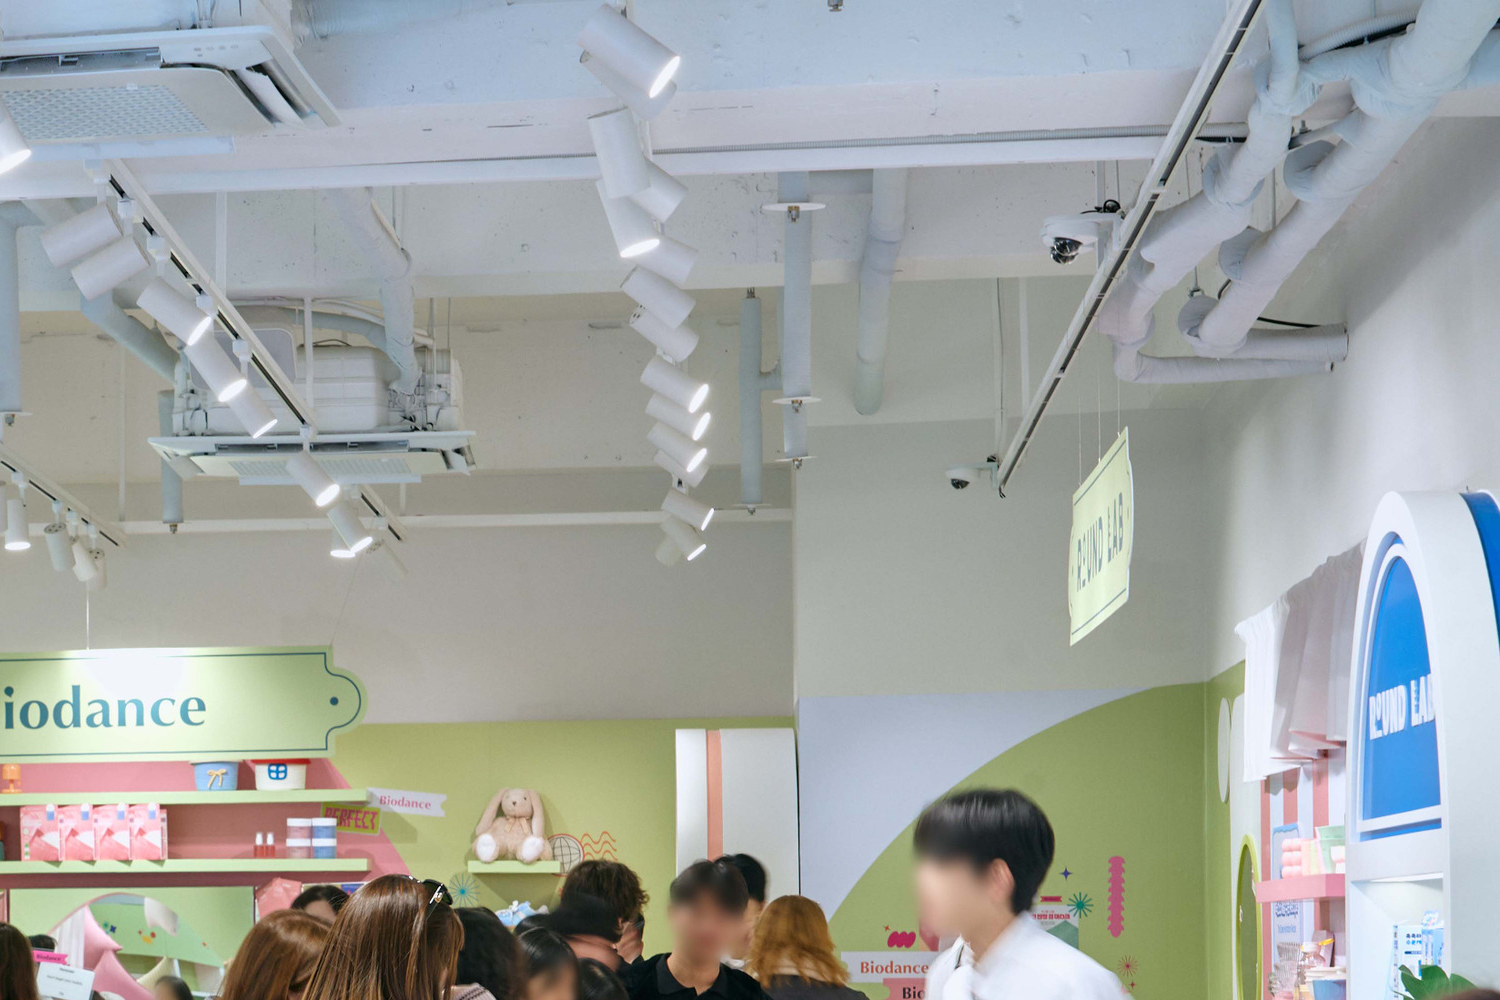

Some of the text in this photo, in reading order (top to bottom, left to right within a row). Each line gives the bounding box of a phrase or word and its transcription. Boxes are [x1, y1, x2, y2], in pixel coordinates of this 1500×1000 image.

[1077, 492, 1124, 592] ROUND LAB
[1369, 685, 1407, 740] ROUND
[379, 795, 431, 810] Biodance
[325, 807, 378, 830] PERFECT
[861, 960, 929, 974] Biodance
[903, 986, 925, 999] Bio
